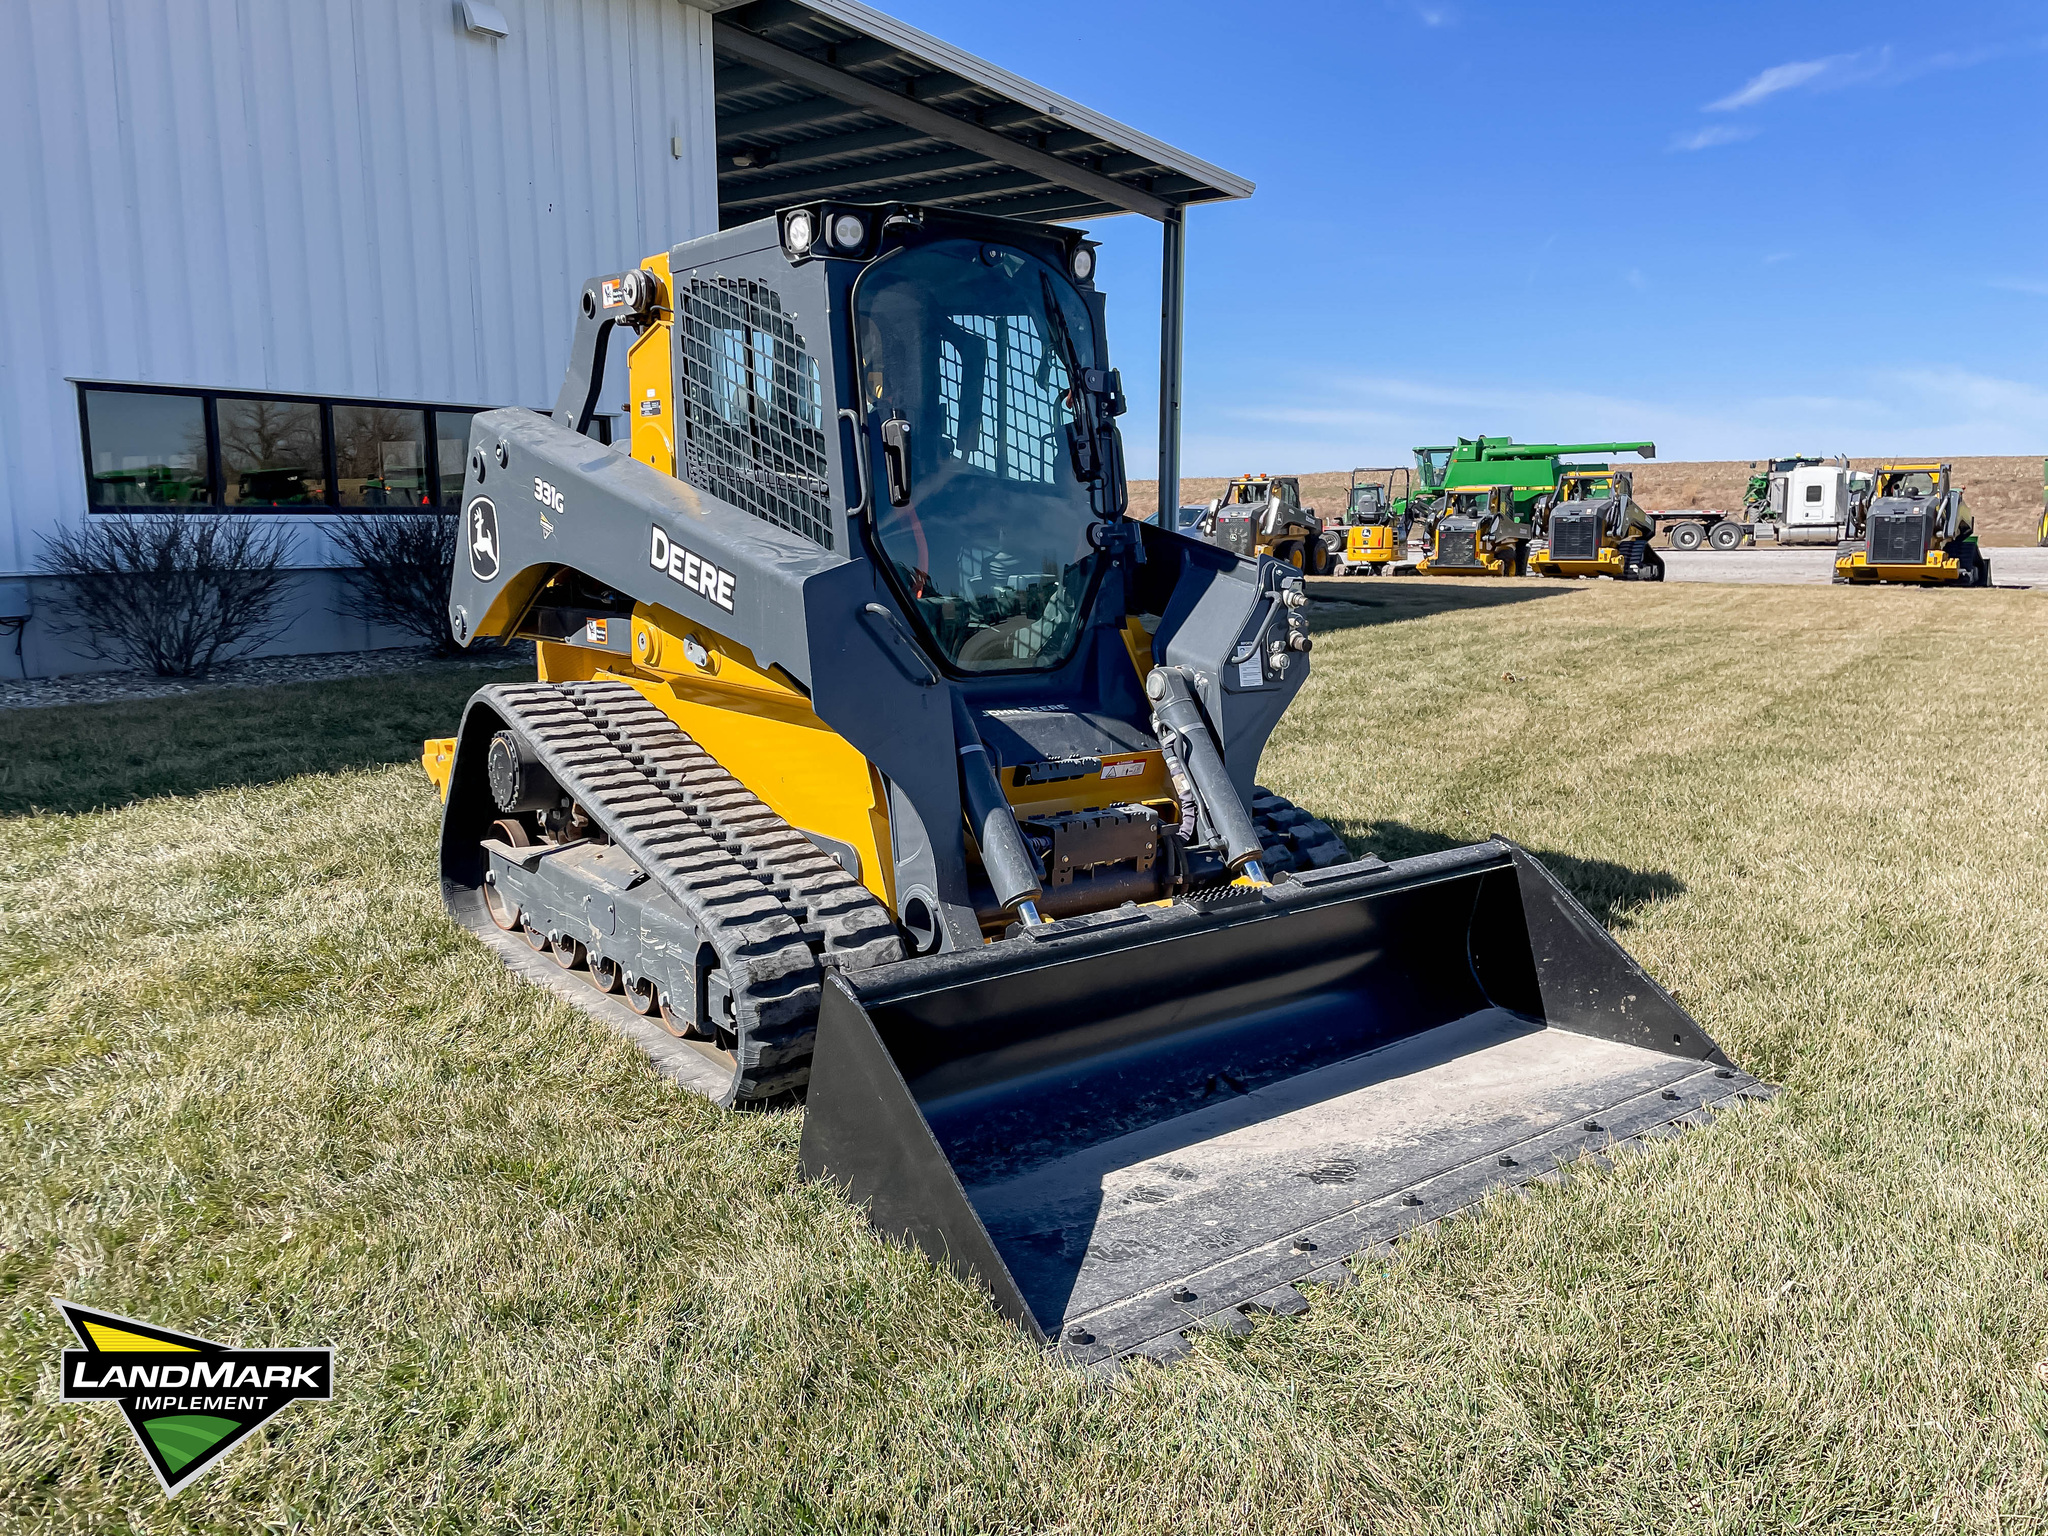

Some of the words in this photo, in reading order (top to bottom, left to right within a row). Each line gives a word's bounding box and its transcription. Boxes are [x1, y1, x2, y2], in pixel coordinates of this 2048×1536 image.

[534, 476, 564, 514] 331G
[650, 525, 736, 612] DEERE
[1019, 703, 1069, 713] DEERE
